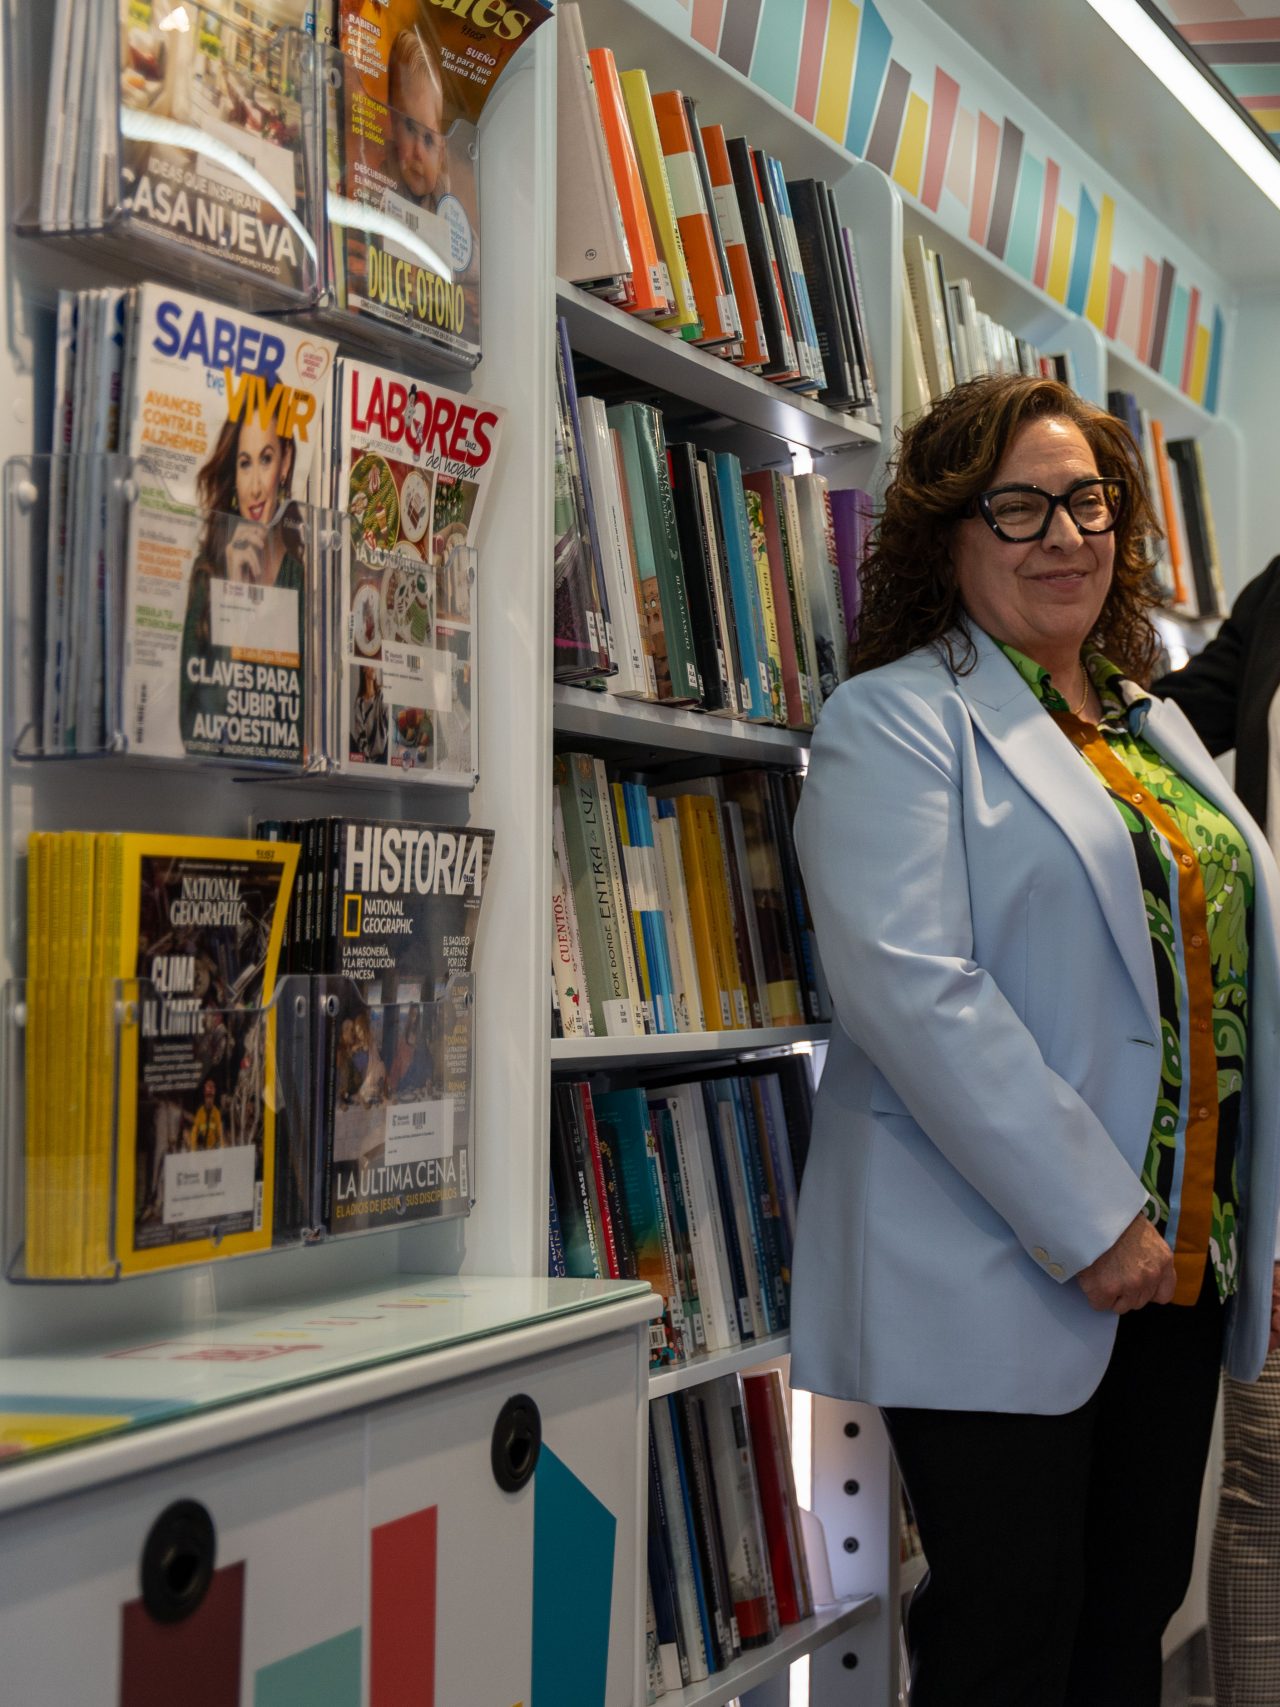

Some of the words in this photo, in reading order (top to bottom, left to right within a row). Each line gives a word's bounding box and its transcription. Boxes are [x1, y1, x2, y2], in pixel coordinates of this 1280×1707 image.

[349, 14, 381, 37] RABIETAS
[441, 47, 455, 61] Tips
[457, 57, 474, 73] para
[477, 66, 492, 77] que
[466, 47, 497, 66] SUEÑO
[442, 60, 468, 77] duerma
[470, 72, 487, 85] bien
[208, 180, 261, 213] INSPIRAN
[197, 199, 298, 266] NUEVA
[369, 245, 413, 312] DULCE
[153, 300, 286, 388] SABER
[145, 390, 202, 417] AVANCES
[224, 366, 317, 443] VIVIR
[351, 369, 499, 467] LABORES
[144, 408, 193, 431] CONTRA
[142, 427, 207, 454] ALZHEIMER
[426, 449, 441, 470] del
[444, 454, 480, 481] hogar
[762, 572, 774, 614] Austen
[768, 617, 777, 643] Jane
[187, 656, 254, 689] CLAVES
[257, 667, 300, 695] PARA
[227, 689, 275, 719] SUBIR
[278, 696, 299, 720] TU
[192, 713, 299, 747] AUTOESTIMA
[579, 787, 596, 824] LUZ
[344, 825, 483, 897] HISTORIA
[604, 804, 612, 848] FANTASMA
[615, 882, 625, 924] PALABRAS
[181, 877, 241, 900] NATIONAL
[592, 847, 611, 919] ENTRA
[170, 901, 247, 926] GEOGRAPHIC
[364, 899, 404, 916] NATIONAL
[362, 917, 414, 934] GEOGRAPHIC
[443, 936, 450, 946] EL
[450, 935, 470, 946] SAQUEO
[552, 895, 571, 964] CUENTOS
[342, 946, 352, 957] LA
[352, 943, 389, 957] MASONERÍA
[443, 947, 450, 957] DE
[450, 947, 468, 957] ATENAS
[605, 923, 617, 968] DONDE
[152, 956, 195, 992] CLIMA
[341, 969, 375, 980] FRANCESA
[348, 958, 356, 968] LA
[356, 956, 396, 968] REVOLUCIÓN
[447, 957, 456, 967] POR
[456, 957, 467, 967] LOS
[611, 971, 622, 997] POR
[142, 1000, 159, 1037] AL
[337, 1167, 357, 1200] LA
[416, 1158, 456, 1188] CENA
[577, 1170, 587, 1197] PASE
[336, 1205, 345, 1218] EL
[370, 1200, 379, 1213] DE
[406, 1194, 419, 1207] SUS
[583, 1197, 596, 1255] TORMENTA
[553, 1229, 566, 1277] CIXIN
[606, 1216, 620, 1276] LECTURA
[551, 1266, 560, 1278] LA
[592, 1256, 600, 1272] LA
